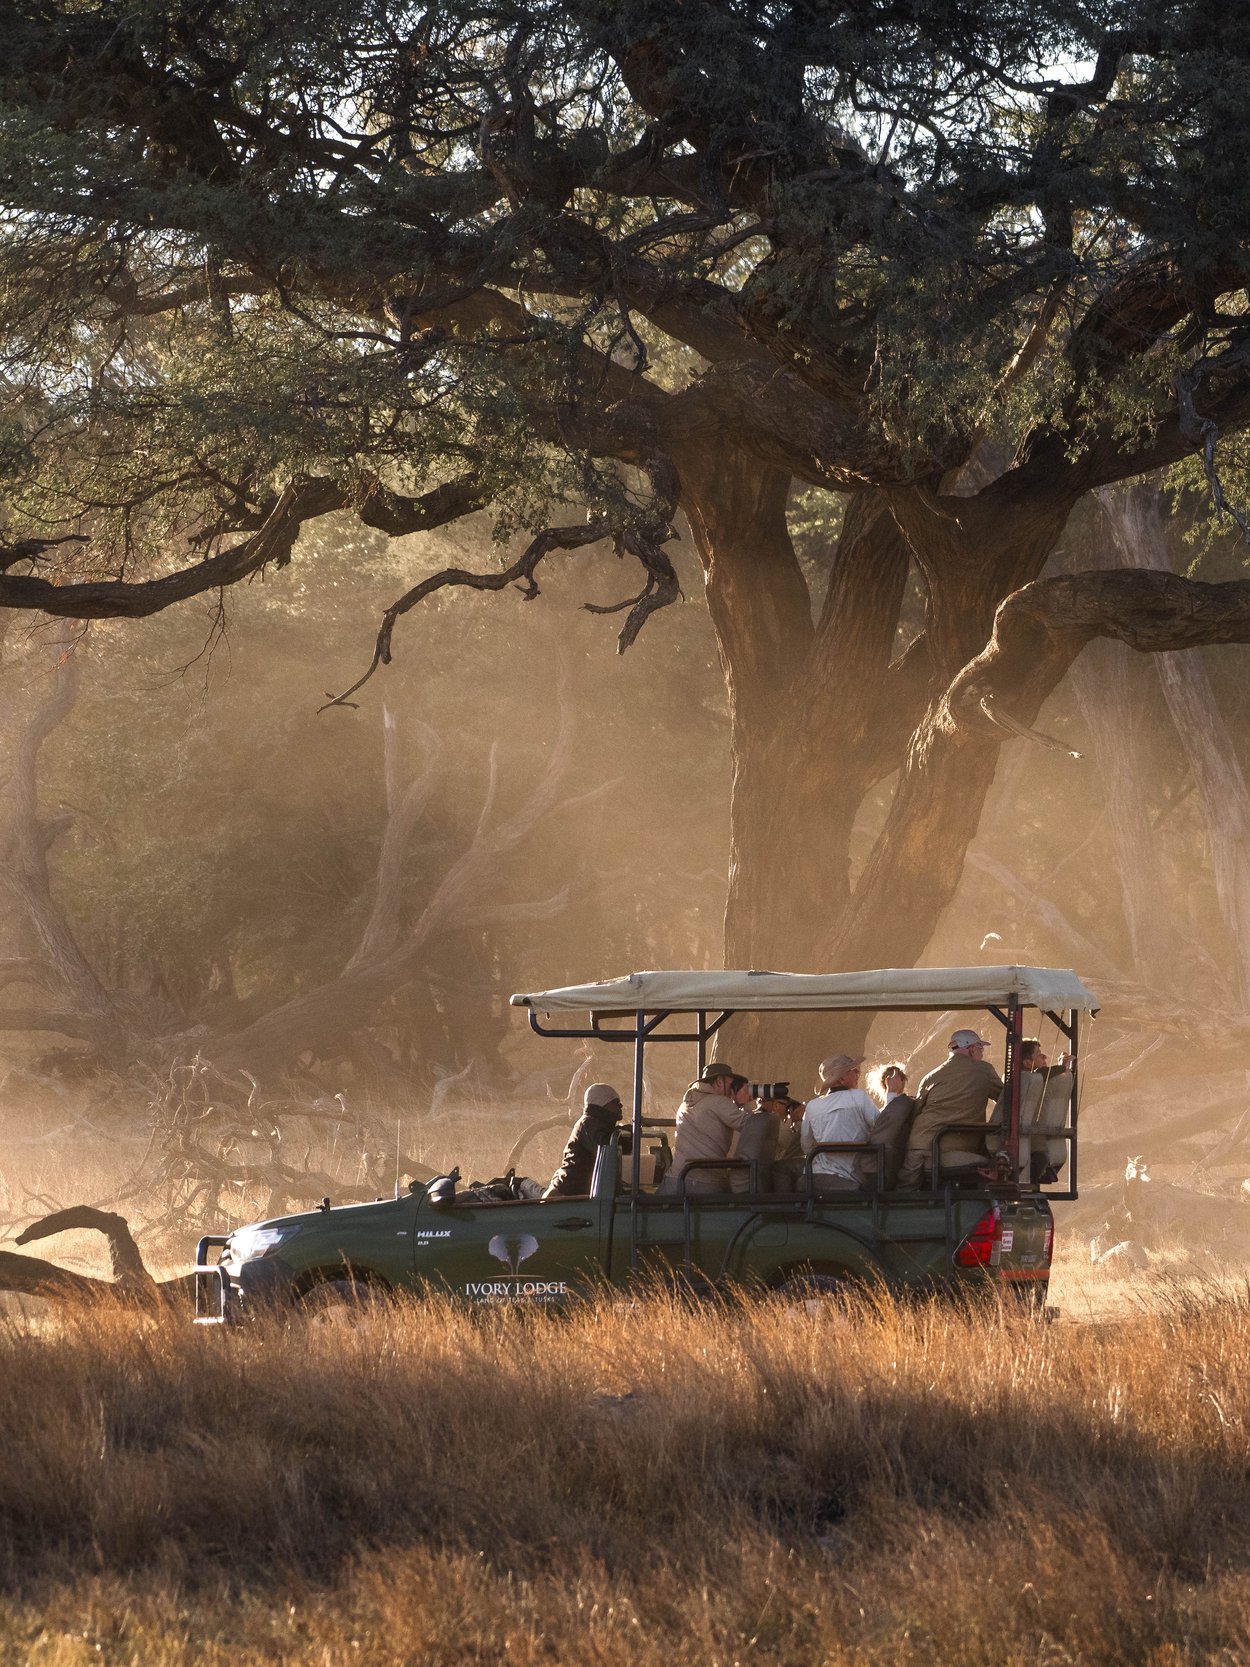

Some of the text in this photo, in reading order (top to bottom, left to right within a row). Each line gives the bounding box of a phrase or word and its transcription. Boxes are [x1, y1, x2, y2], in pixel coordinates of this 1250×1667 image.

[417, 1230, 451, 1238] HILUX
[466, 1282, 567, 1296] IVORY LODGE
